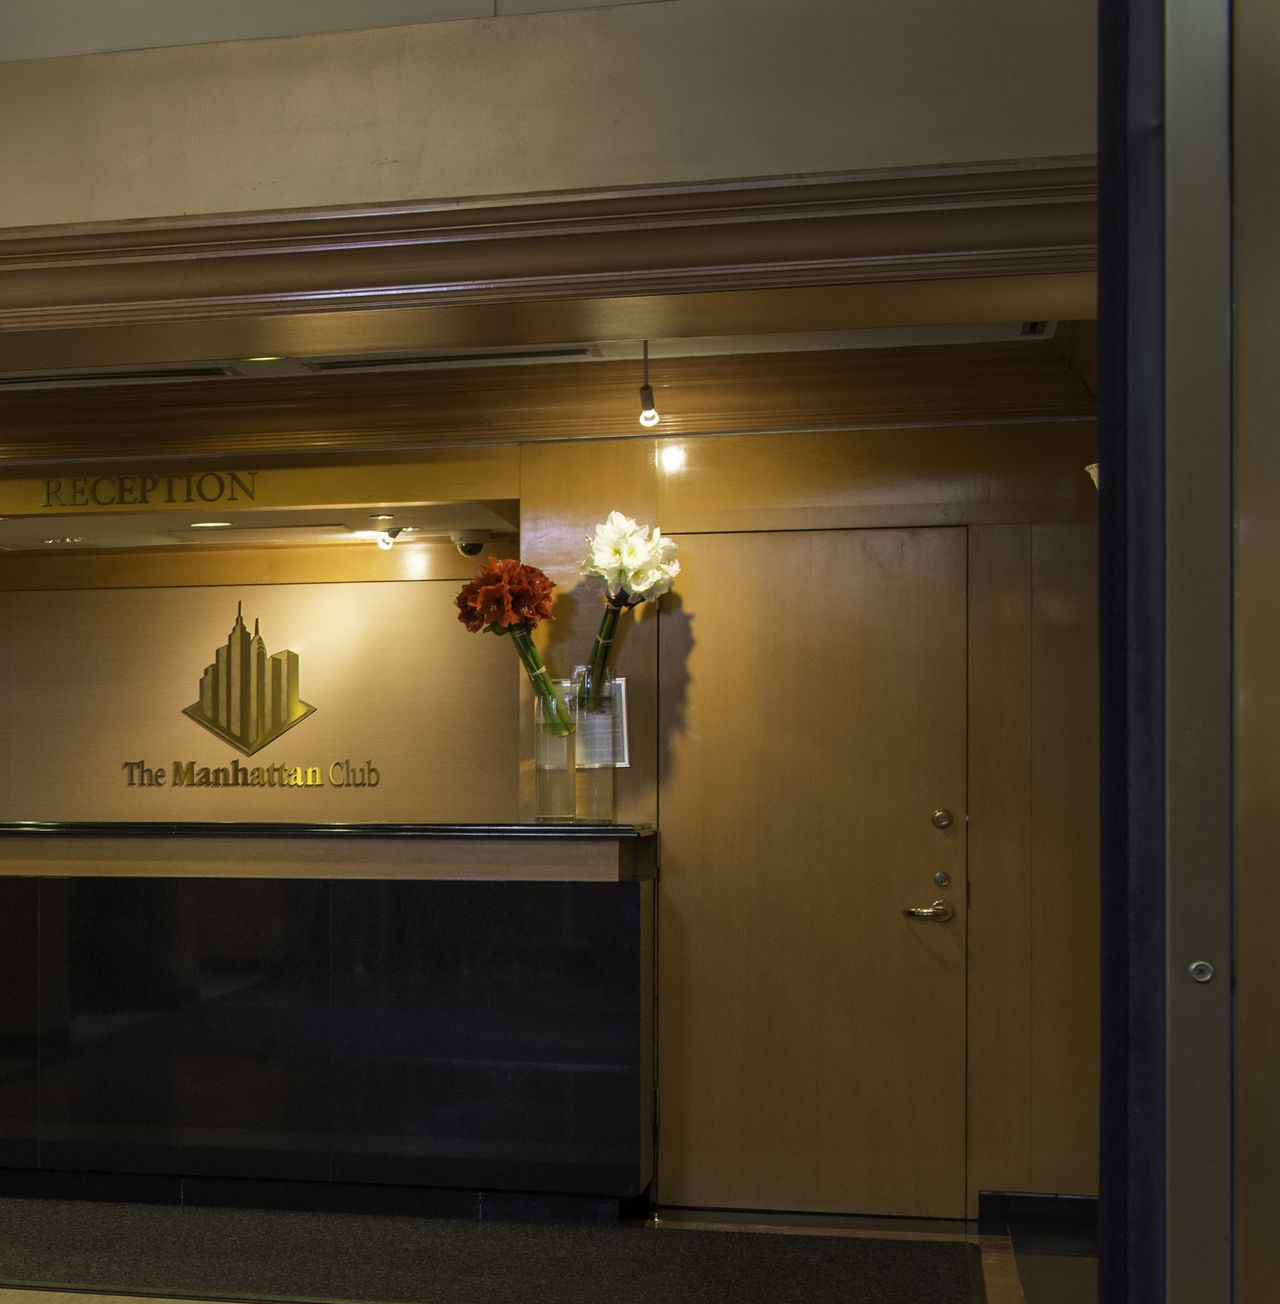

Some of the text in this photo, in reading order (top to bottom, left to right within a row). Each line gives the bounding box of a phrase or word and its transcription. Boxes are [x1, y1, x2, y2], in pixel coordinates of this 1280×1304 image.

[40, 471, 258, 507] RECEPTION
[122, 759, 380, 787] The Manhattan Club
